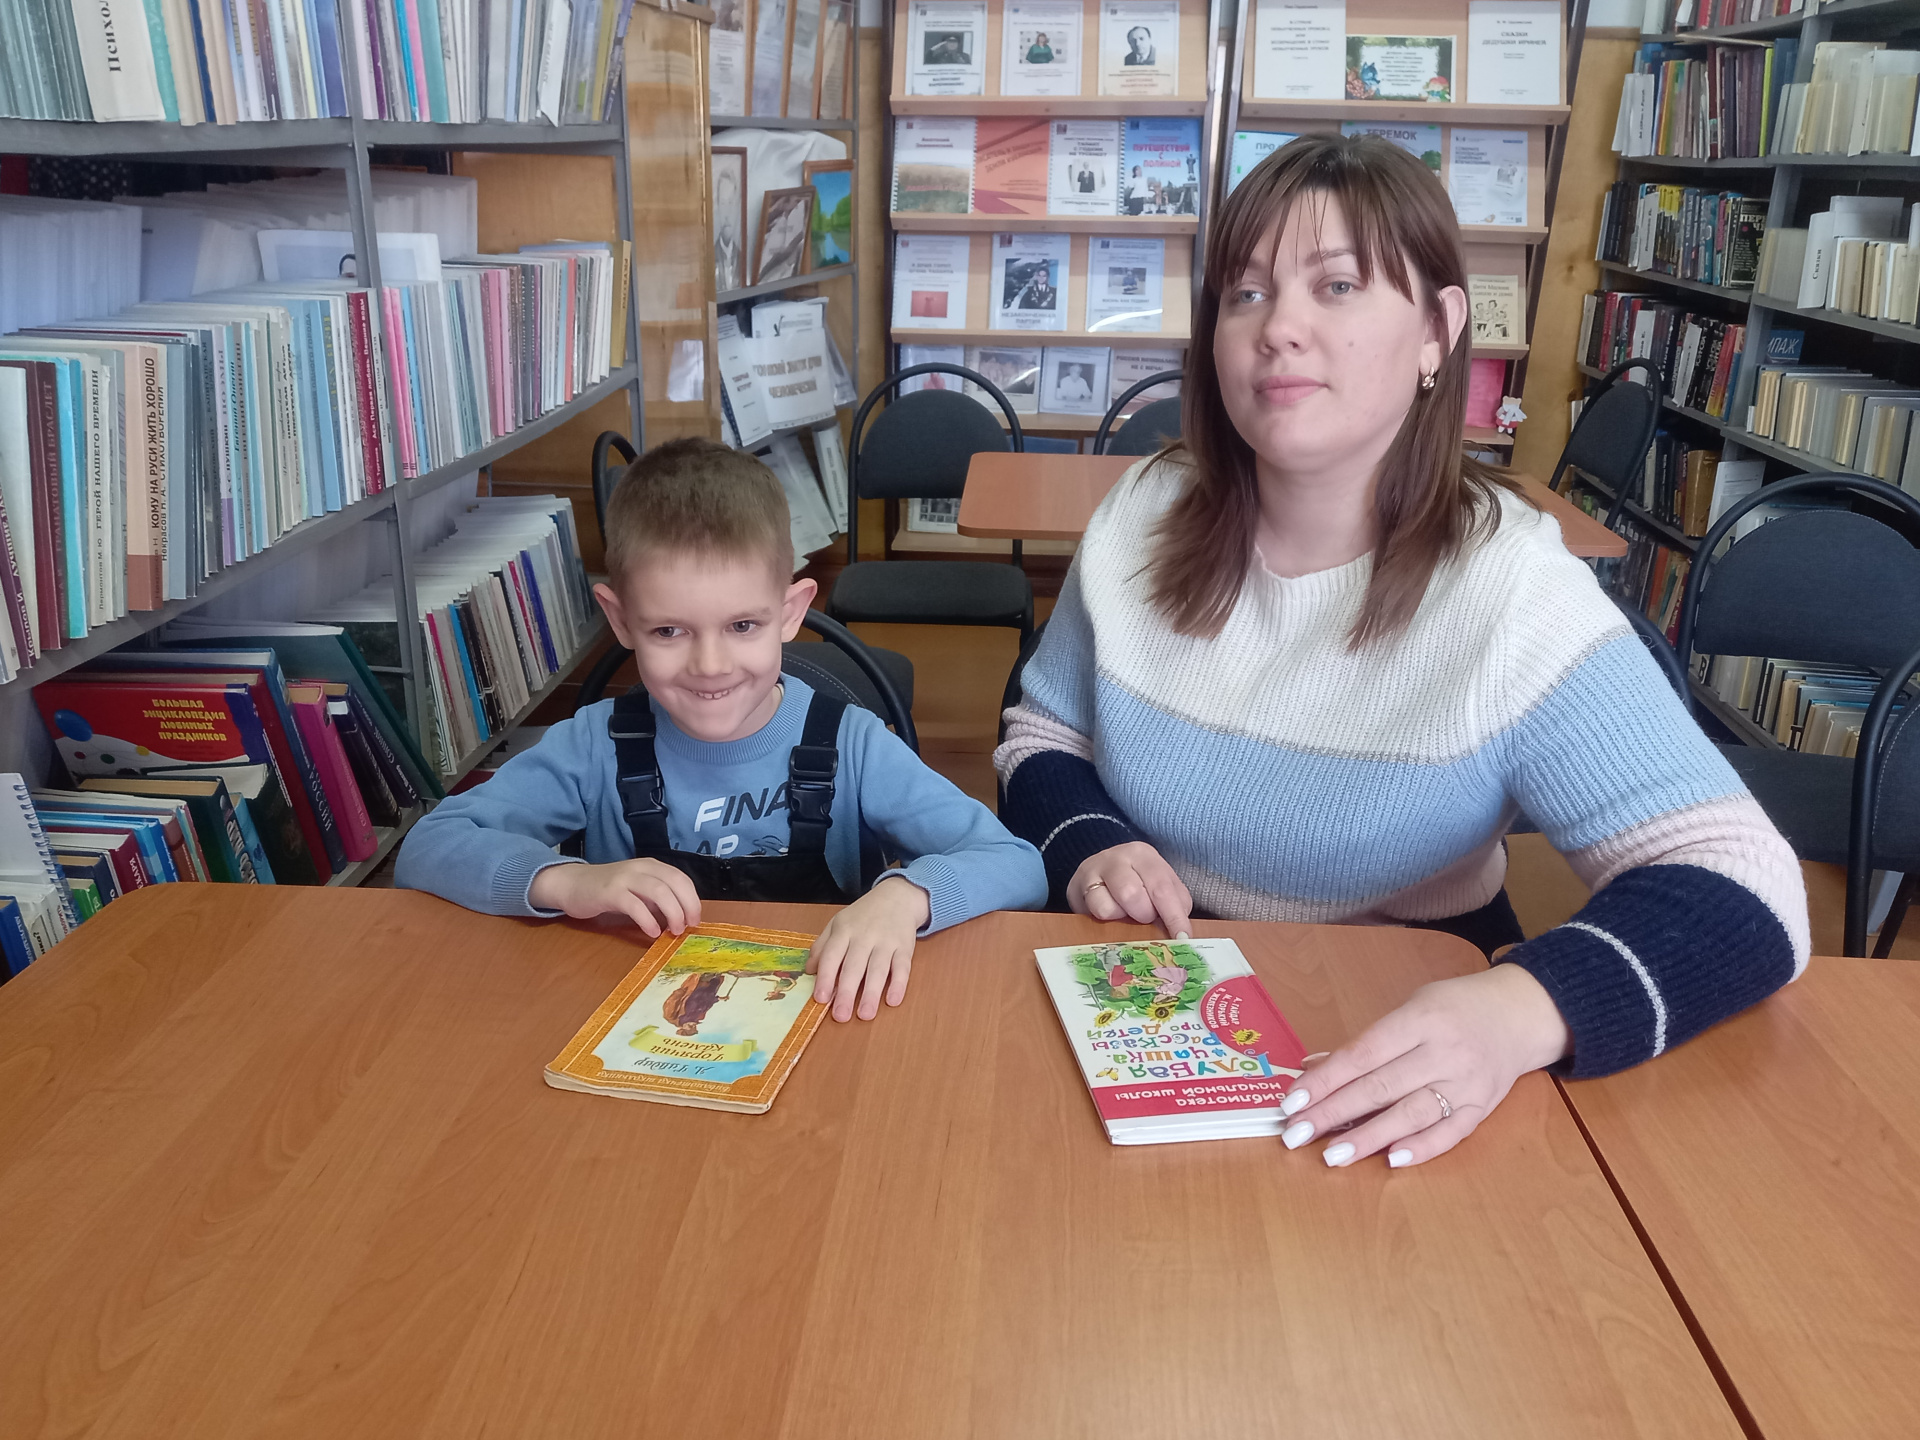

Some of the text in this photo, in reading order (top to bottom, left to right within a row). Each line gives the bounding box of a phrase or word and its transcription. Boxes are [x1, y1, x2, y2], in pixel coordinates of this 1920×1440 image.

[1812, 248, 1823, 280] Сказки
[359, 297, 367, 321] воды
[144, 357, 156, 409] ХОРОШО
[235, 342, 244, 397] ОНЕГИН
[91, 368, 100, 430] ВРЕМЕНИ
[368, 391, 376, 421] Первая
[43, 380, 57, 449] БРАСЛЕТ
[146, 411, 158, 444] ЖИТЬ
[93, 432, 101, 486] НАШЕГО
[147, 446, 158, 476] РУСИ
[47, 450, 62, 553] ГРАНАТОВЫЙ
[149, 479, 159, 496] НА
[93, 489, 102, 531] ГЕРОЙ
[149, 497, 160, 530] КОМУ
[142, 710, 227, 722] ЭНЦИКЛОПЕДИЯ
[152, 698, 205, 709] БОЛЬШАЯ
[158, 732, 228, 742] ПРАЗДНИКОВ
[160, 721, 216, 731] ЛЮБИМЫХ
[308, 770, 333, 832] РОССИИ
[226, 819, 246, 859] МИР
[1205, 992, 1221, 1029] ЖЕЛЕЗНИКОВ
[1218, 993, 1233, 1027] М. ГОРЬКИЙ
[1228, 996, 1243, 1026] А. ГАЙДАР
[662, 1037, 725, 1054] камень
[1086, 1022, 1203, 1042] про детей
[1091, 1031, 1222, 1051] Рассказы
[631, 1056, 688, 1075] Гайдар
[649, 1045, 725, 1063] Горячий
[595, 1070, 731, 1095] Библиотечка школьника
[1114, 1082, 1281, 1101] начальной школы
[1175, 1093, 1287, 1108] Библиотека
